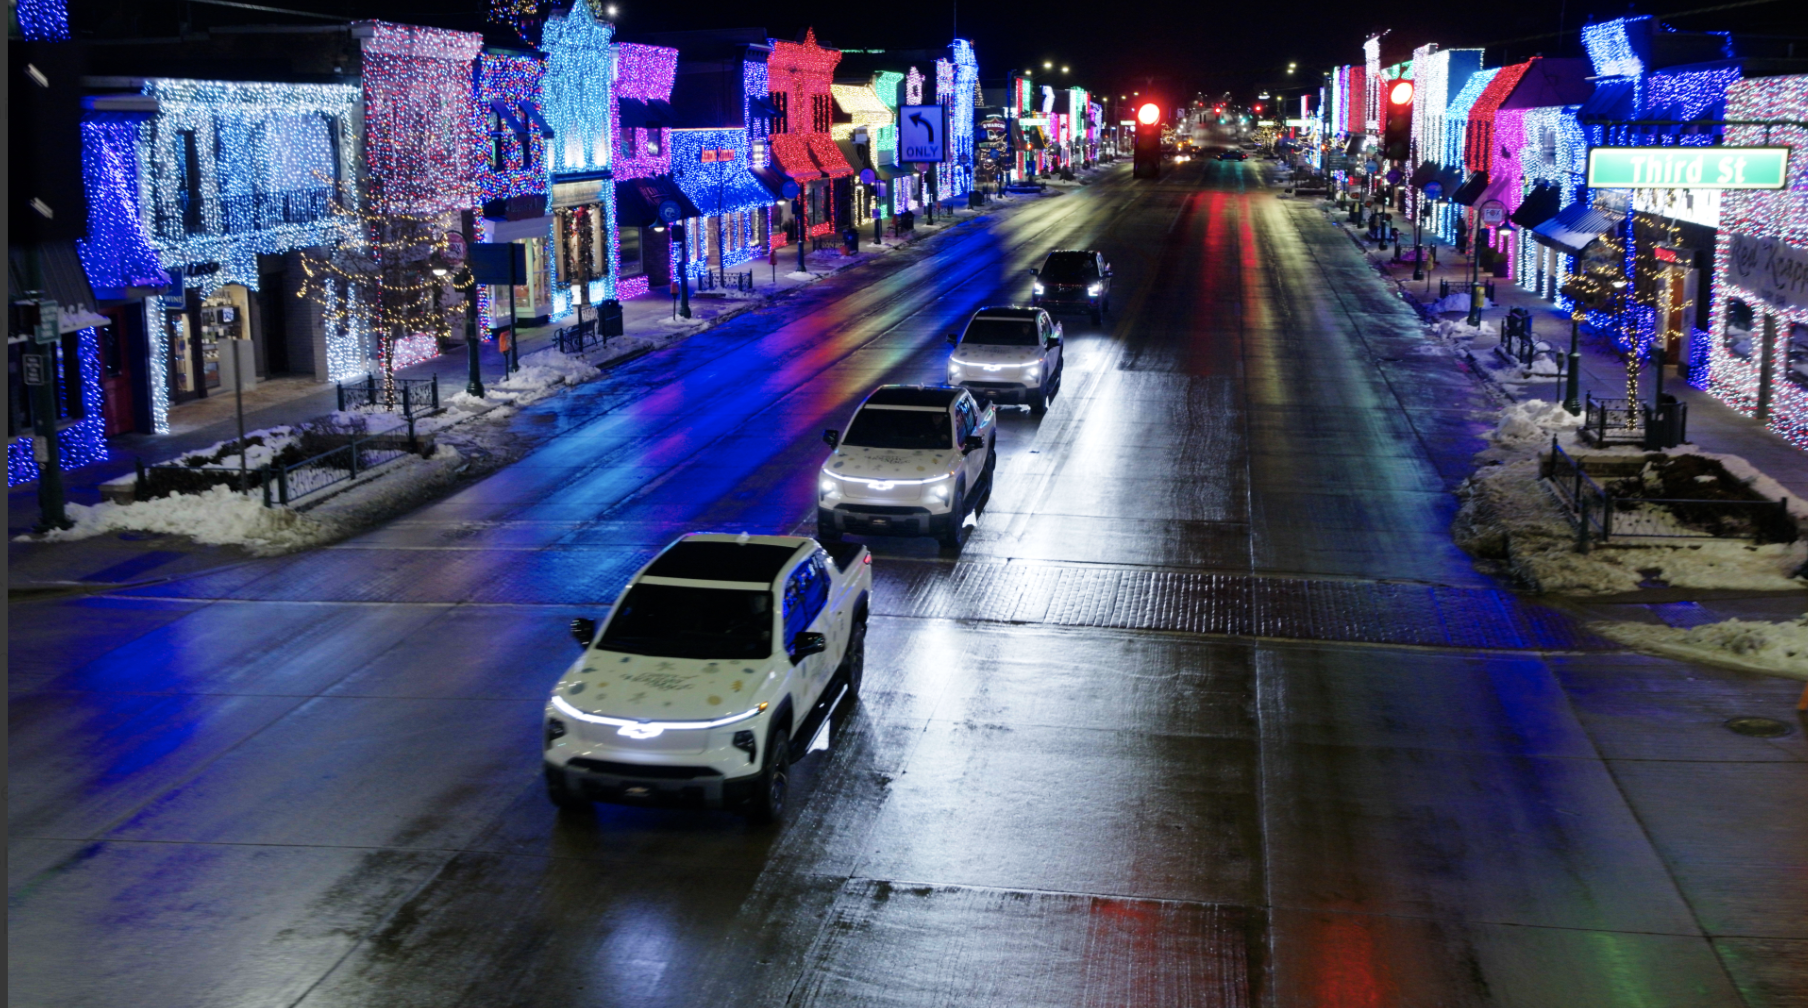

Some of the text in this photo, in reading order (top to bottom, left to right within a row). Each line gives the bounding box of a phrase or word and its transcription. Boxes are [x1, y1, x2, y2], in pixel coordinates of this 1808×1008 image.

[906, 146, 938, 157] ONLY
[1630, 154, 1747, 184] Third St
[1731, 239, 1758, 277] Red
[164, 295, 183, 304] WINE
